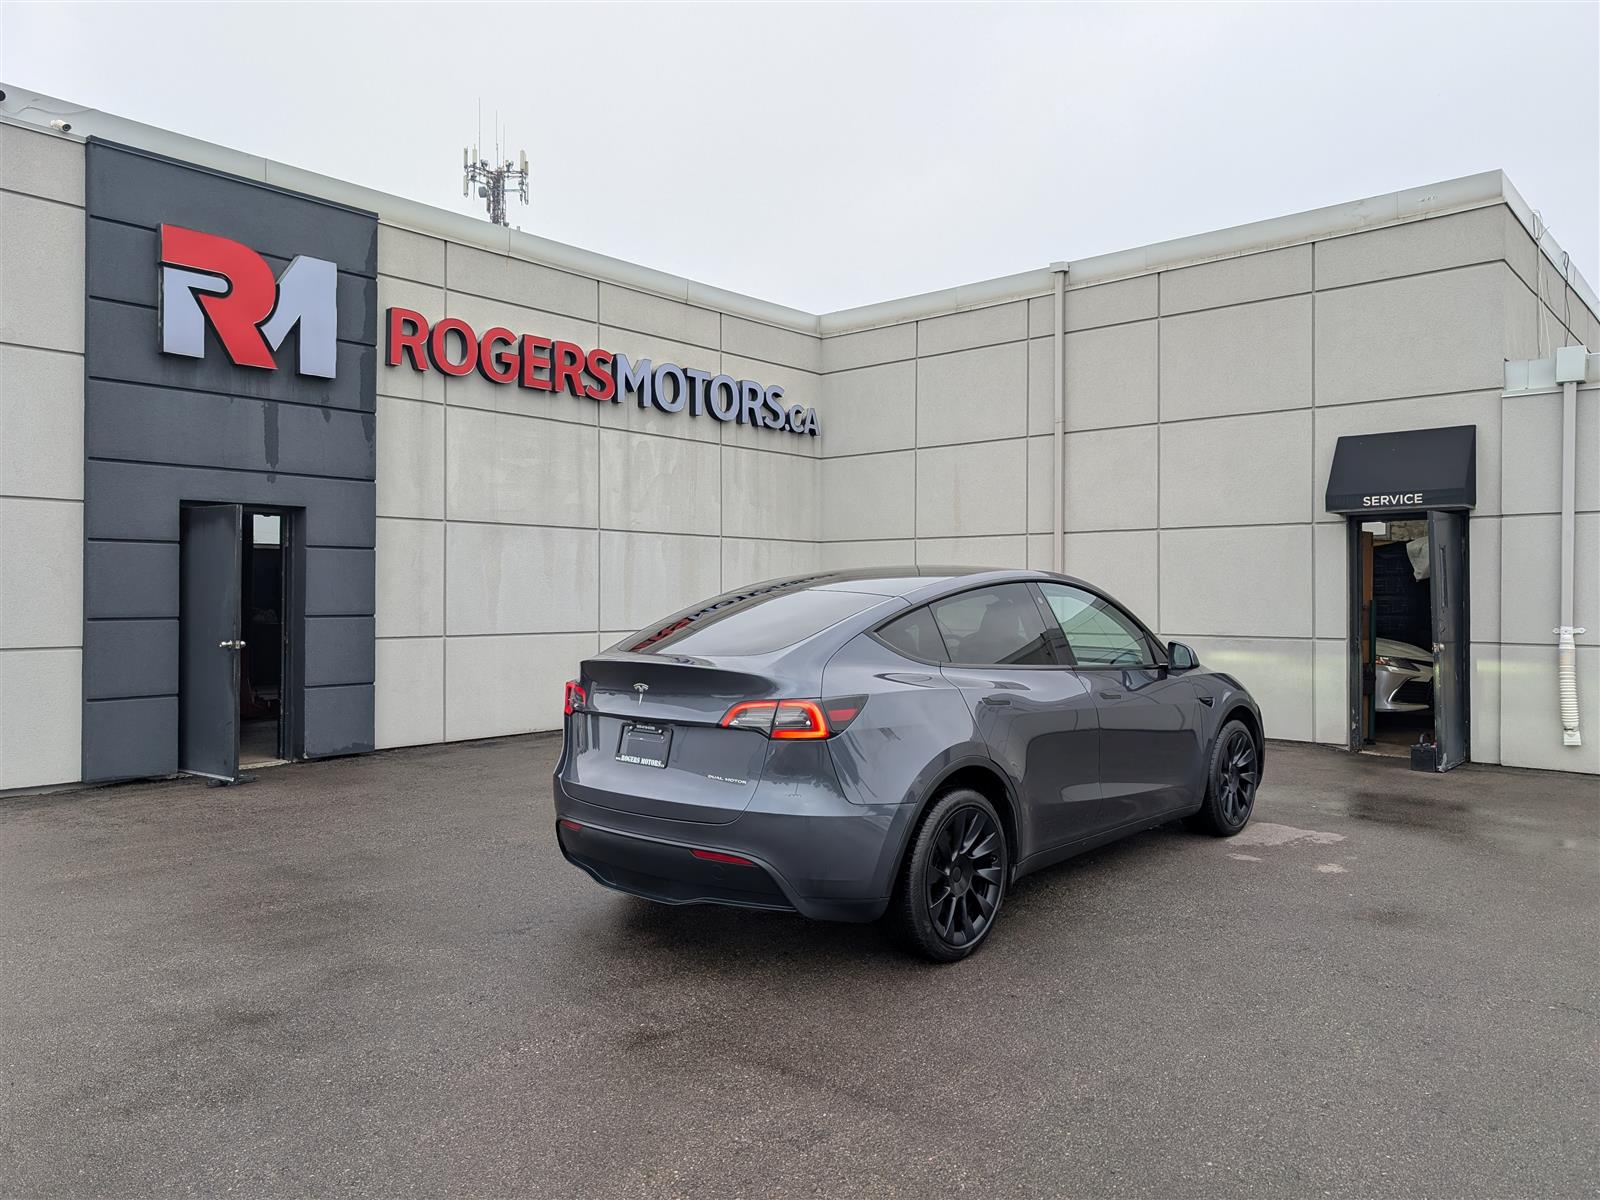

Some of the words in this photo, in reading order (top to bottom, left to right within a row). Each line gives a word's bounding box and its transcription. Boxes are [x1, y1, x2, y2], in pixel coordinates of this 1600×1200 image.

[158, 223, 338, 379] RM
[1362, 493, 1423, 507] SERVICE
[620, 754, 641, 765] ROGERS
[640, 757, 662, 768] MOTORS
[724, 777, 747, 785] MOTOR
